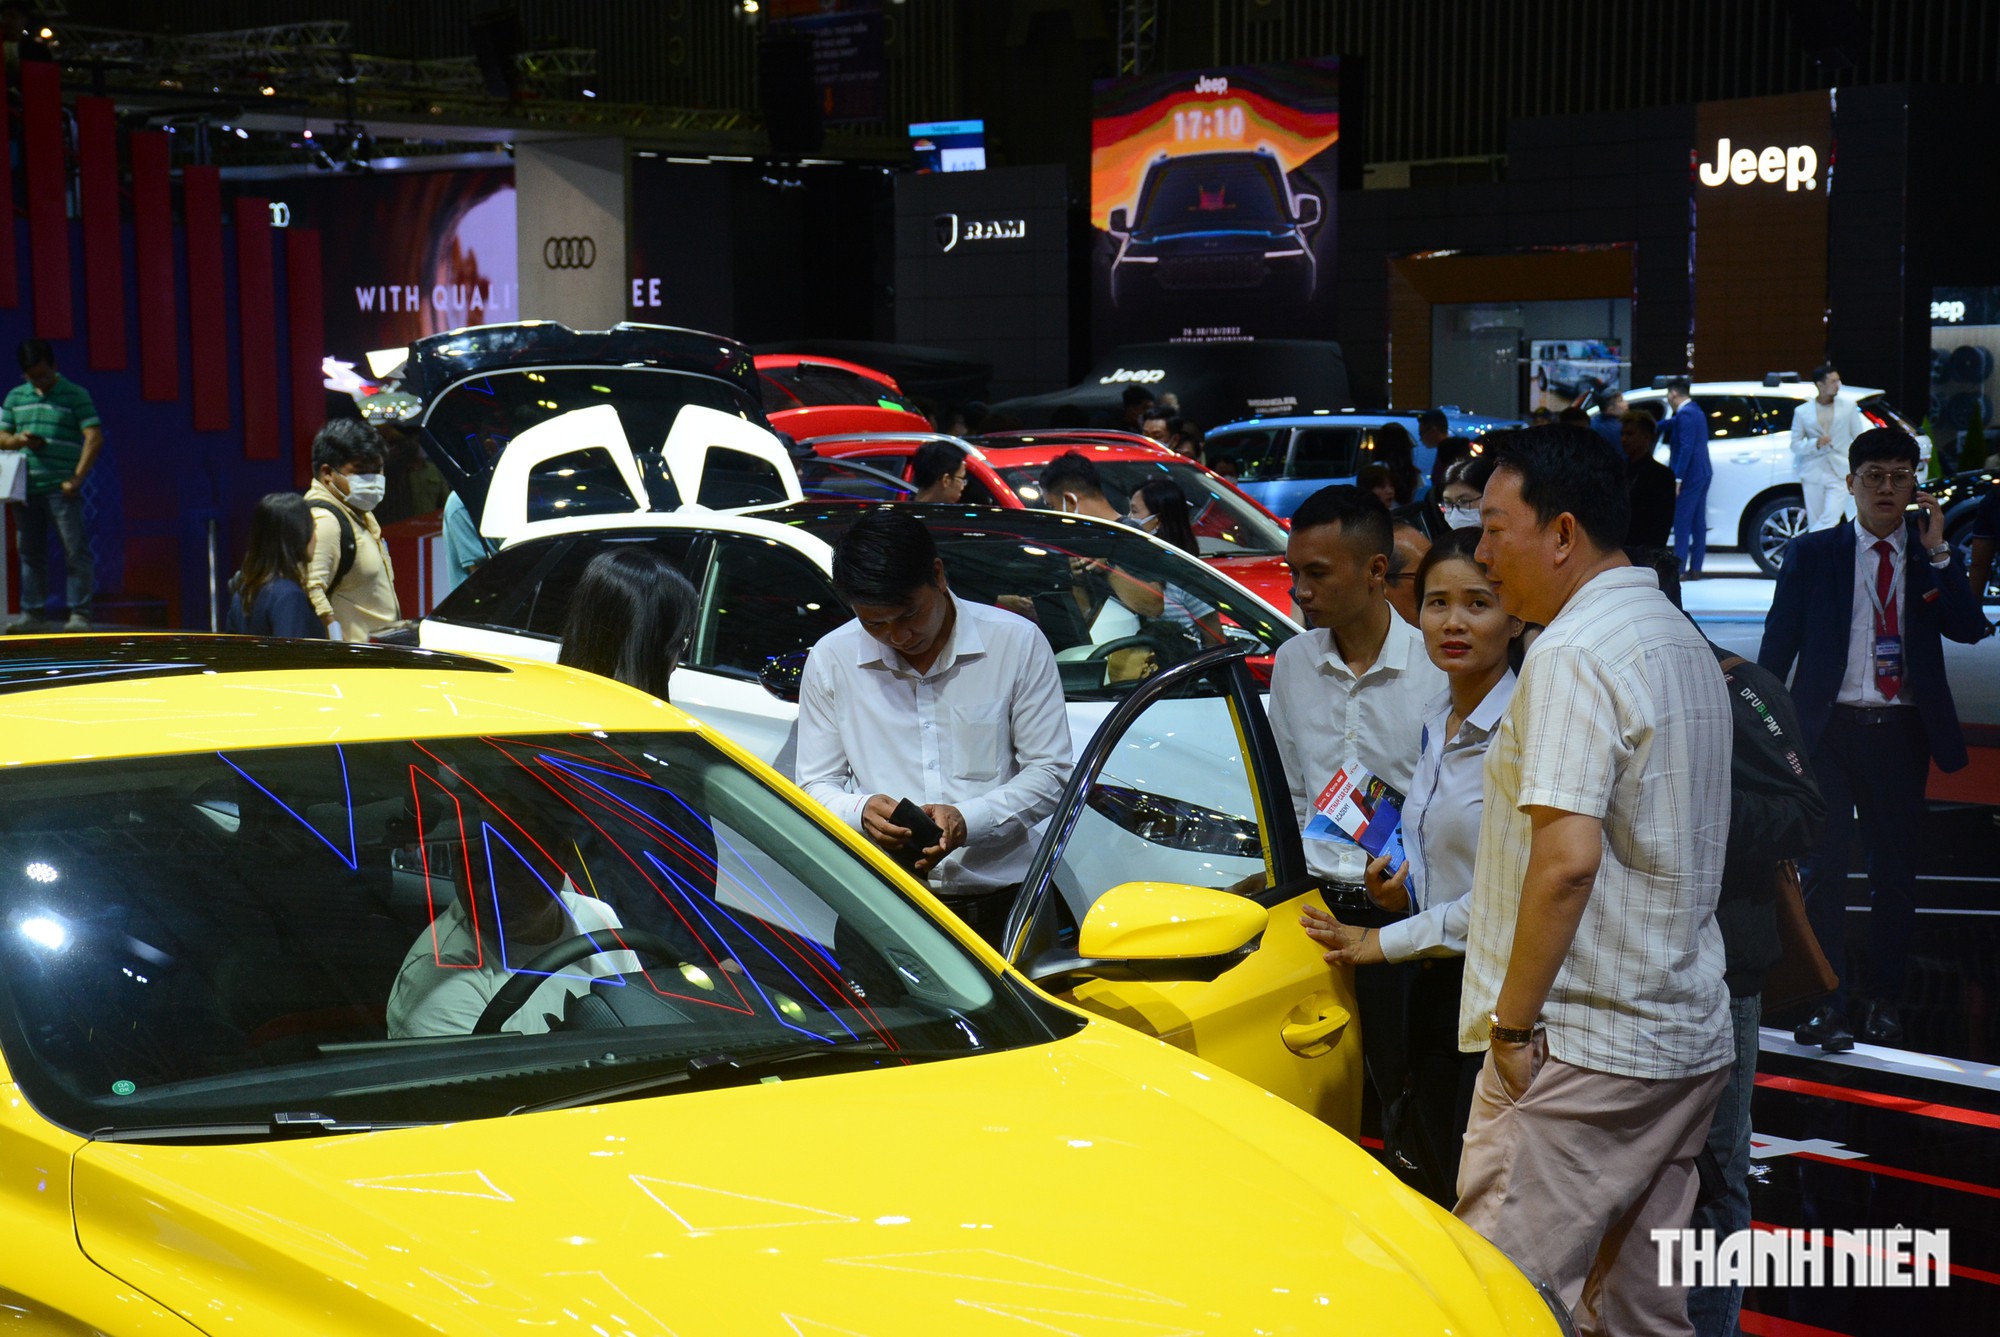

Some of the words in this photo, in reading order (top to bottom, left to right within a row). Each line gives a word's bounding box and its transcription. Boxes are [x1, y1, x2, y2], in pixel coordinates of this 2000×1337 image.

[1195, 75, 1228, 95] Jeep
[1174, 106, 1244, 140] 17:10
[1699, 138, 1817, 191] Jeep
[964, 220, 1025, 240] RAM
[356, 285, 420, 312] WITH
[432, 284, 517, 312] QUALI
[1930, 301, 1965, 322] eep
[1099, 368, 1165, 384] Jeep
[1326, 798, 1342, 815] VIETNAM
[1338, 789, 1348, 801] CAR
[1343, 781, 1354, 794] CARE
[1334, 803, 1350, 822] ACADEMY
